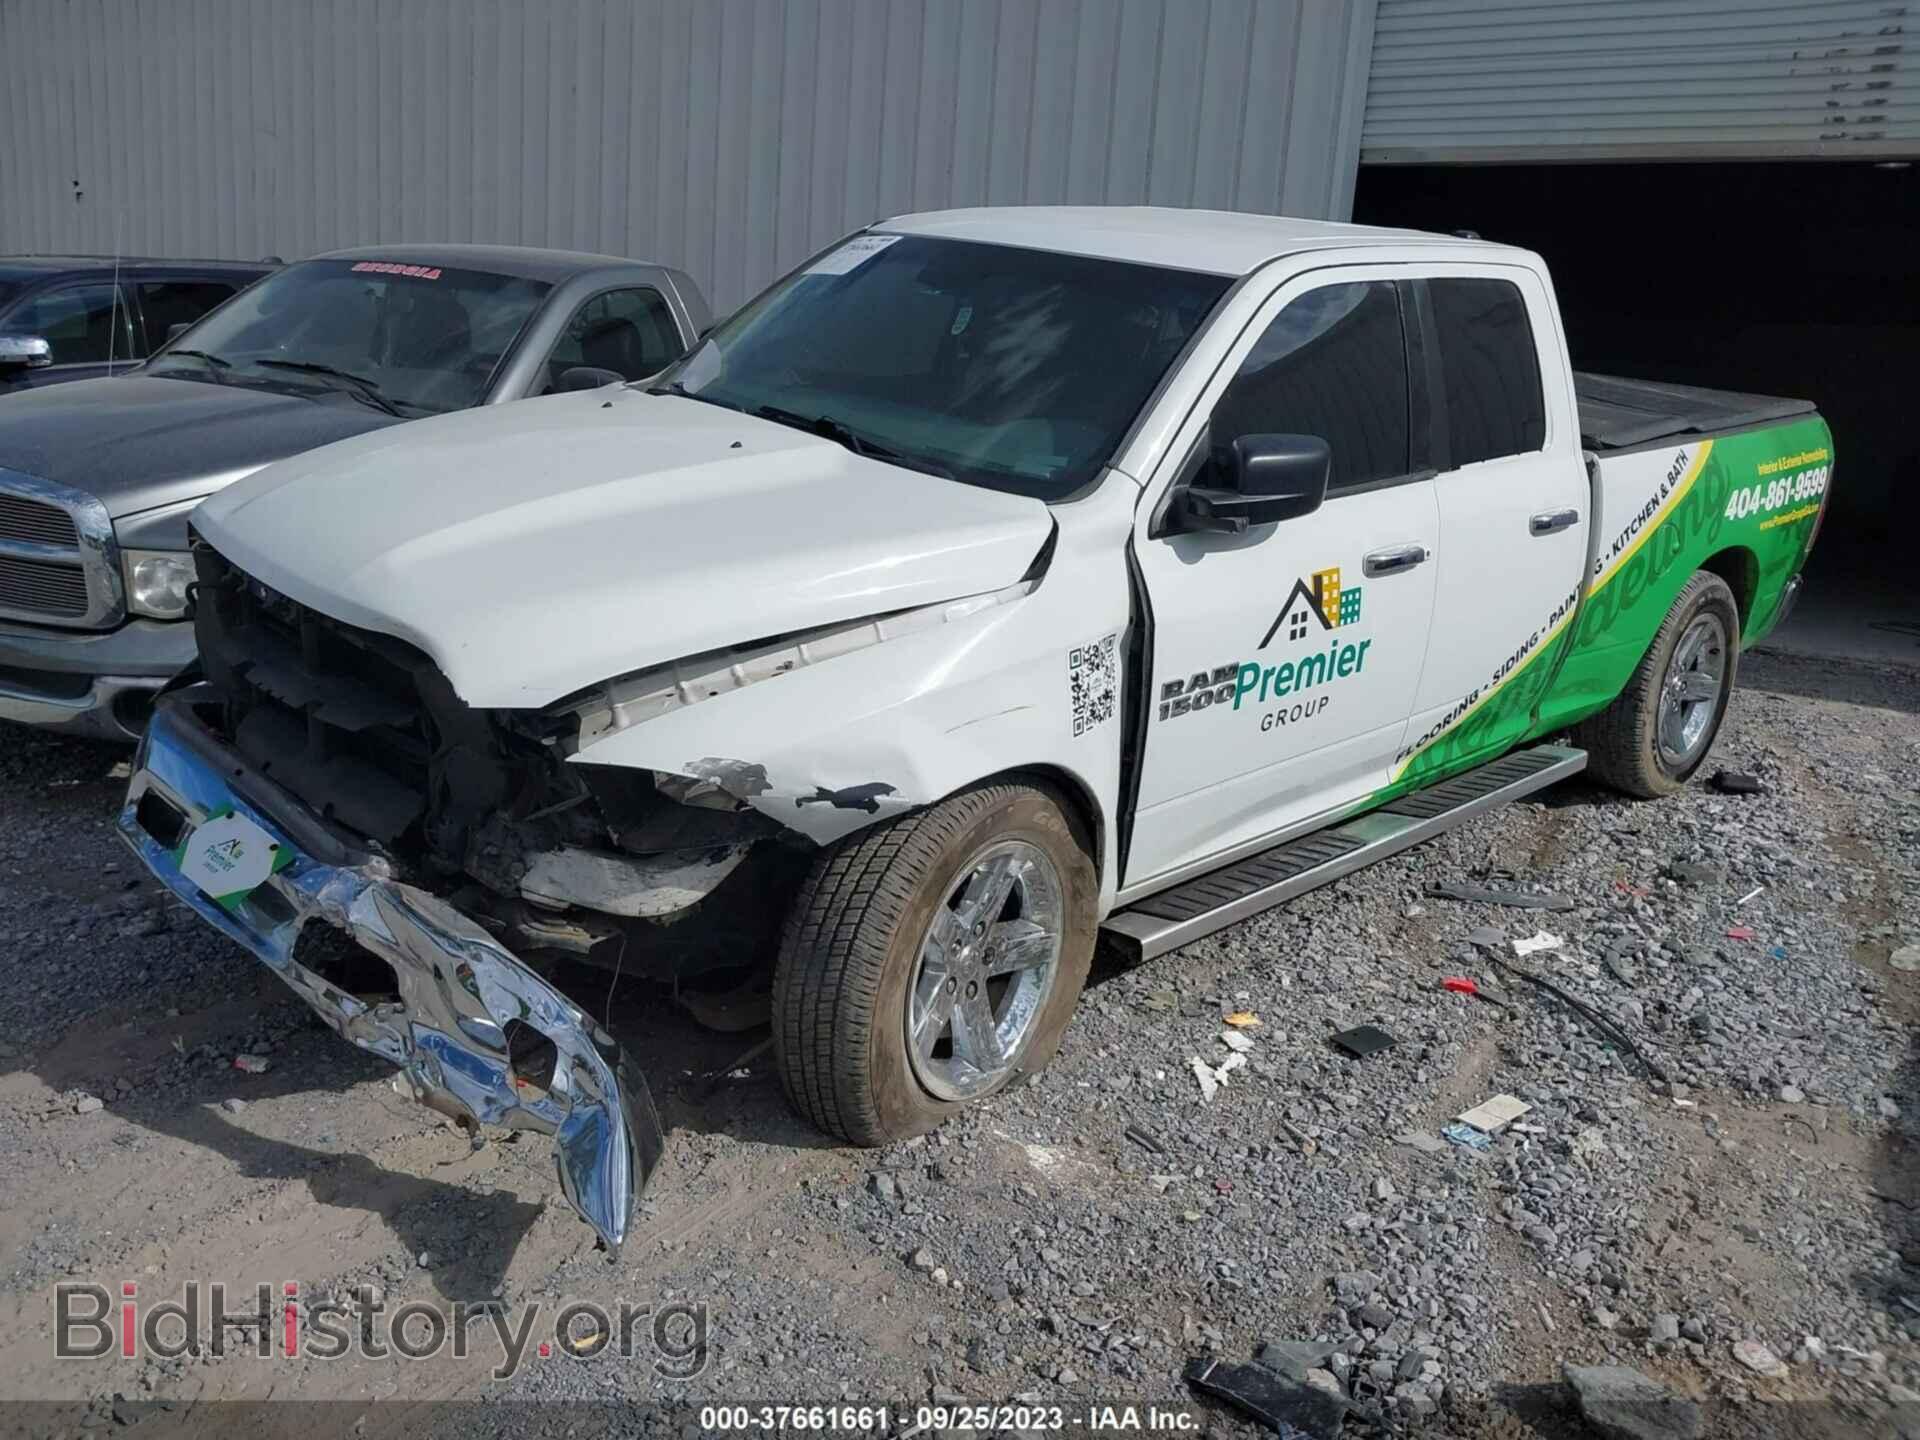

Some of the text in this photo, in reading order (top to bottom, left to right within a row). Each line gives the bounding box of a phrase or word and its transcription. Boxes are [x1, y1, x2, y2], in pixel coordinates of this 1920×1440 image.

[1724, 465, 1828, 520] 404-861-9599
[1395, 689, 1479, 765] FLOORING
[1492, 631, 1539, 686] SIDING
[1612, 492, 1661, 556] KITCHEN
[1660, 482, 1670, 500] &
[1667, 448, 1689, 489] BATH
[1160, 661, 1240, 702] RAM
[1232, 638, 1372, 712] Premier
[1158, 683, 1237, 722] 1500
[1260, 695, 1330, 733] GROUP
